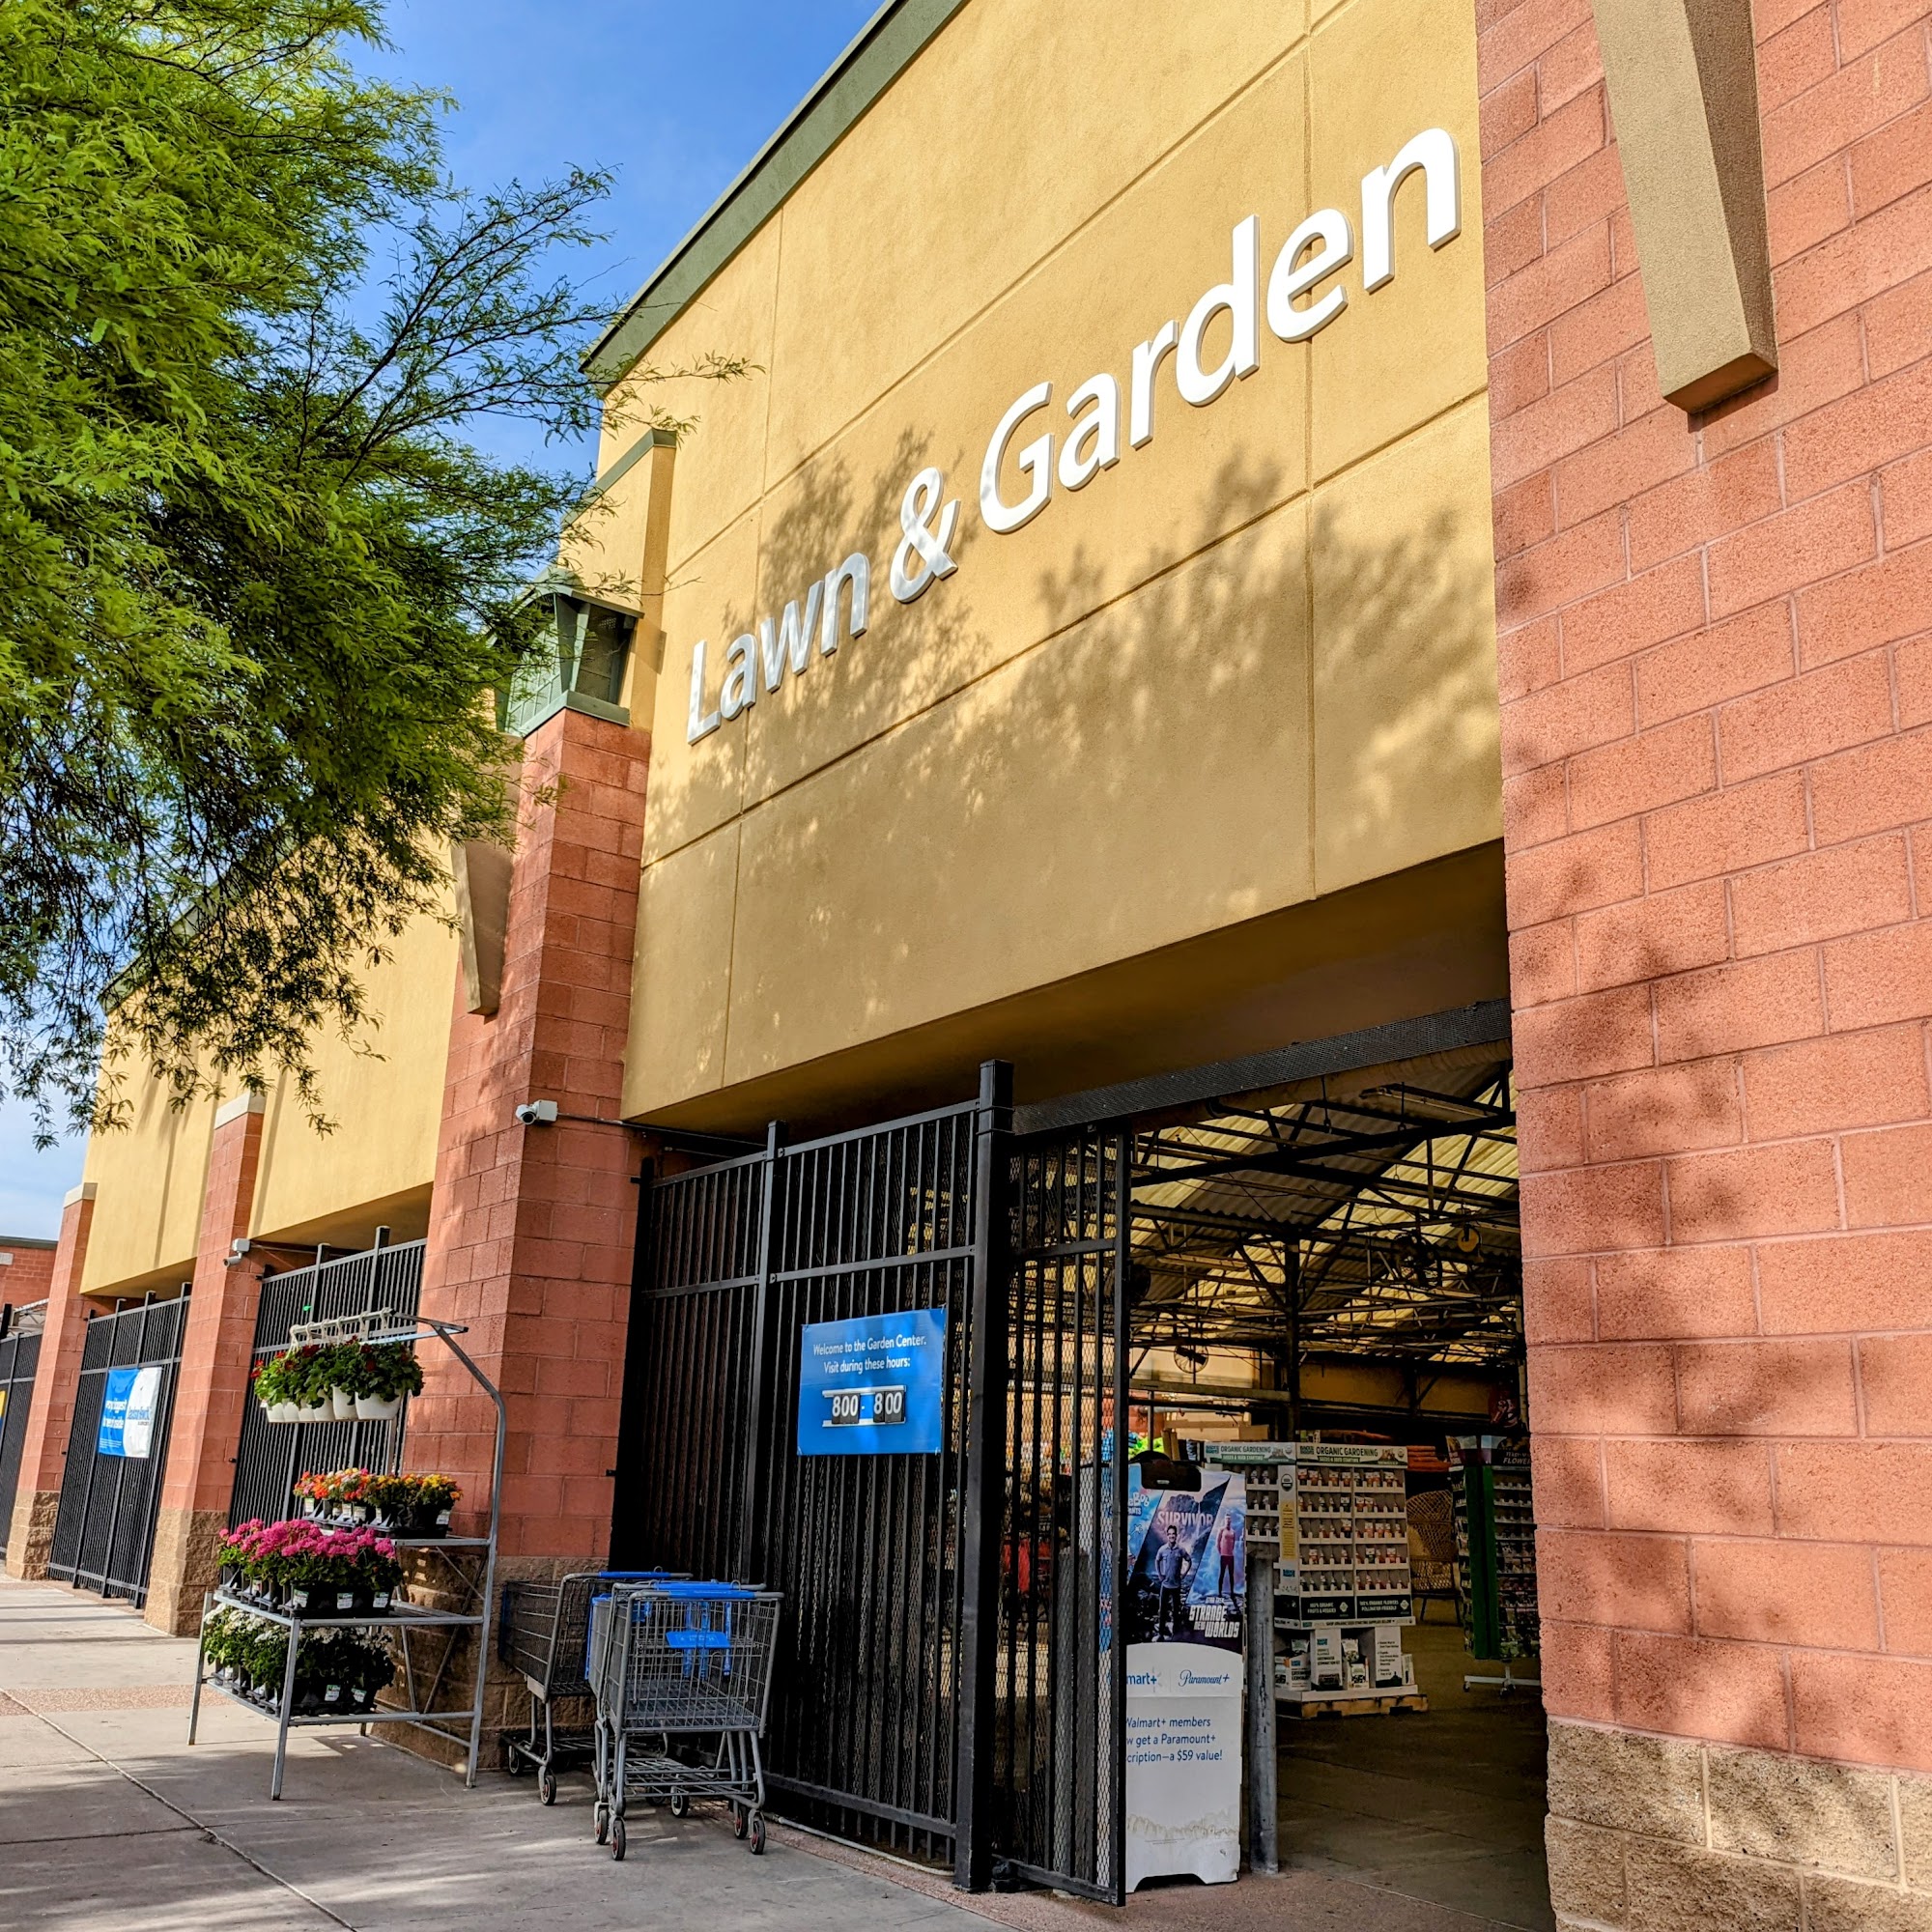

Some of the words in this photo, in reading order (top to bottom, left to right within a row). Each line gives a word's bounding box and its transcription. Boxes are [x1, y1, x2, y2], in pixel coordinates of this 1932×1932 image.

[687, 552, 869, 745] Lawn
[889, 467, 960, 603] &
[980, 128, 1461, 533] Garden
[813, 1343, 843, 1355] Welcome
[844, 1342, 852, 1352] to
[854, 1339, 866, 1351] the
[867, 1335, 895, 1350] Garden
[895, 1334, 926, 1348] Center.
[824, 1361, 839, 1374] Visit
[839, 1359, 863, 1375] during
[865, 1357, 885, 1370] these
[886, 1356, 911, 1369] hours:
[1317, 1446, 1343, 1455] ORGANIC
[1344, 1447, 1378, 1457] GARDENING
[1156, 1511, 1213, 1526] SURVIVOR
[1188, 1605, 1228, 1622] STRANGE
[1193, 1621, 1207, 1631] NEW
[1205, 1621, 1240, 1638] WORLDS
[1125, 1672, 1157, 1685] mart+
[1179, 1669, 1230, 1687] Paramount+
[1169, 1716, 1210, 1727] members
[1136, 1735, 1151, 1747] get
[1161, 1733, 1216, 1745] Paramount+
[1177, 1748, 1193, 1762] $59
[1196, 1749, 1223, 1761] value!
